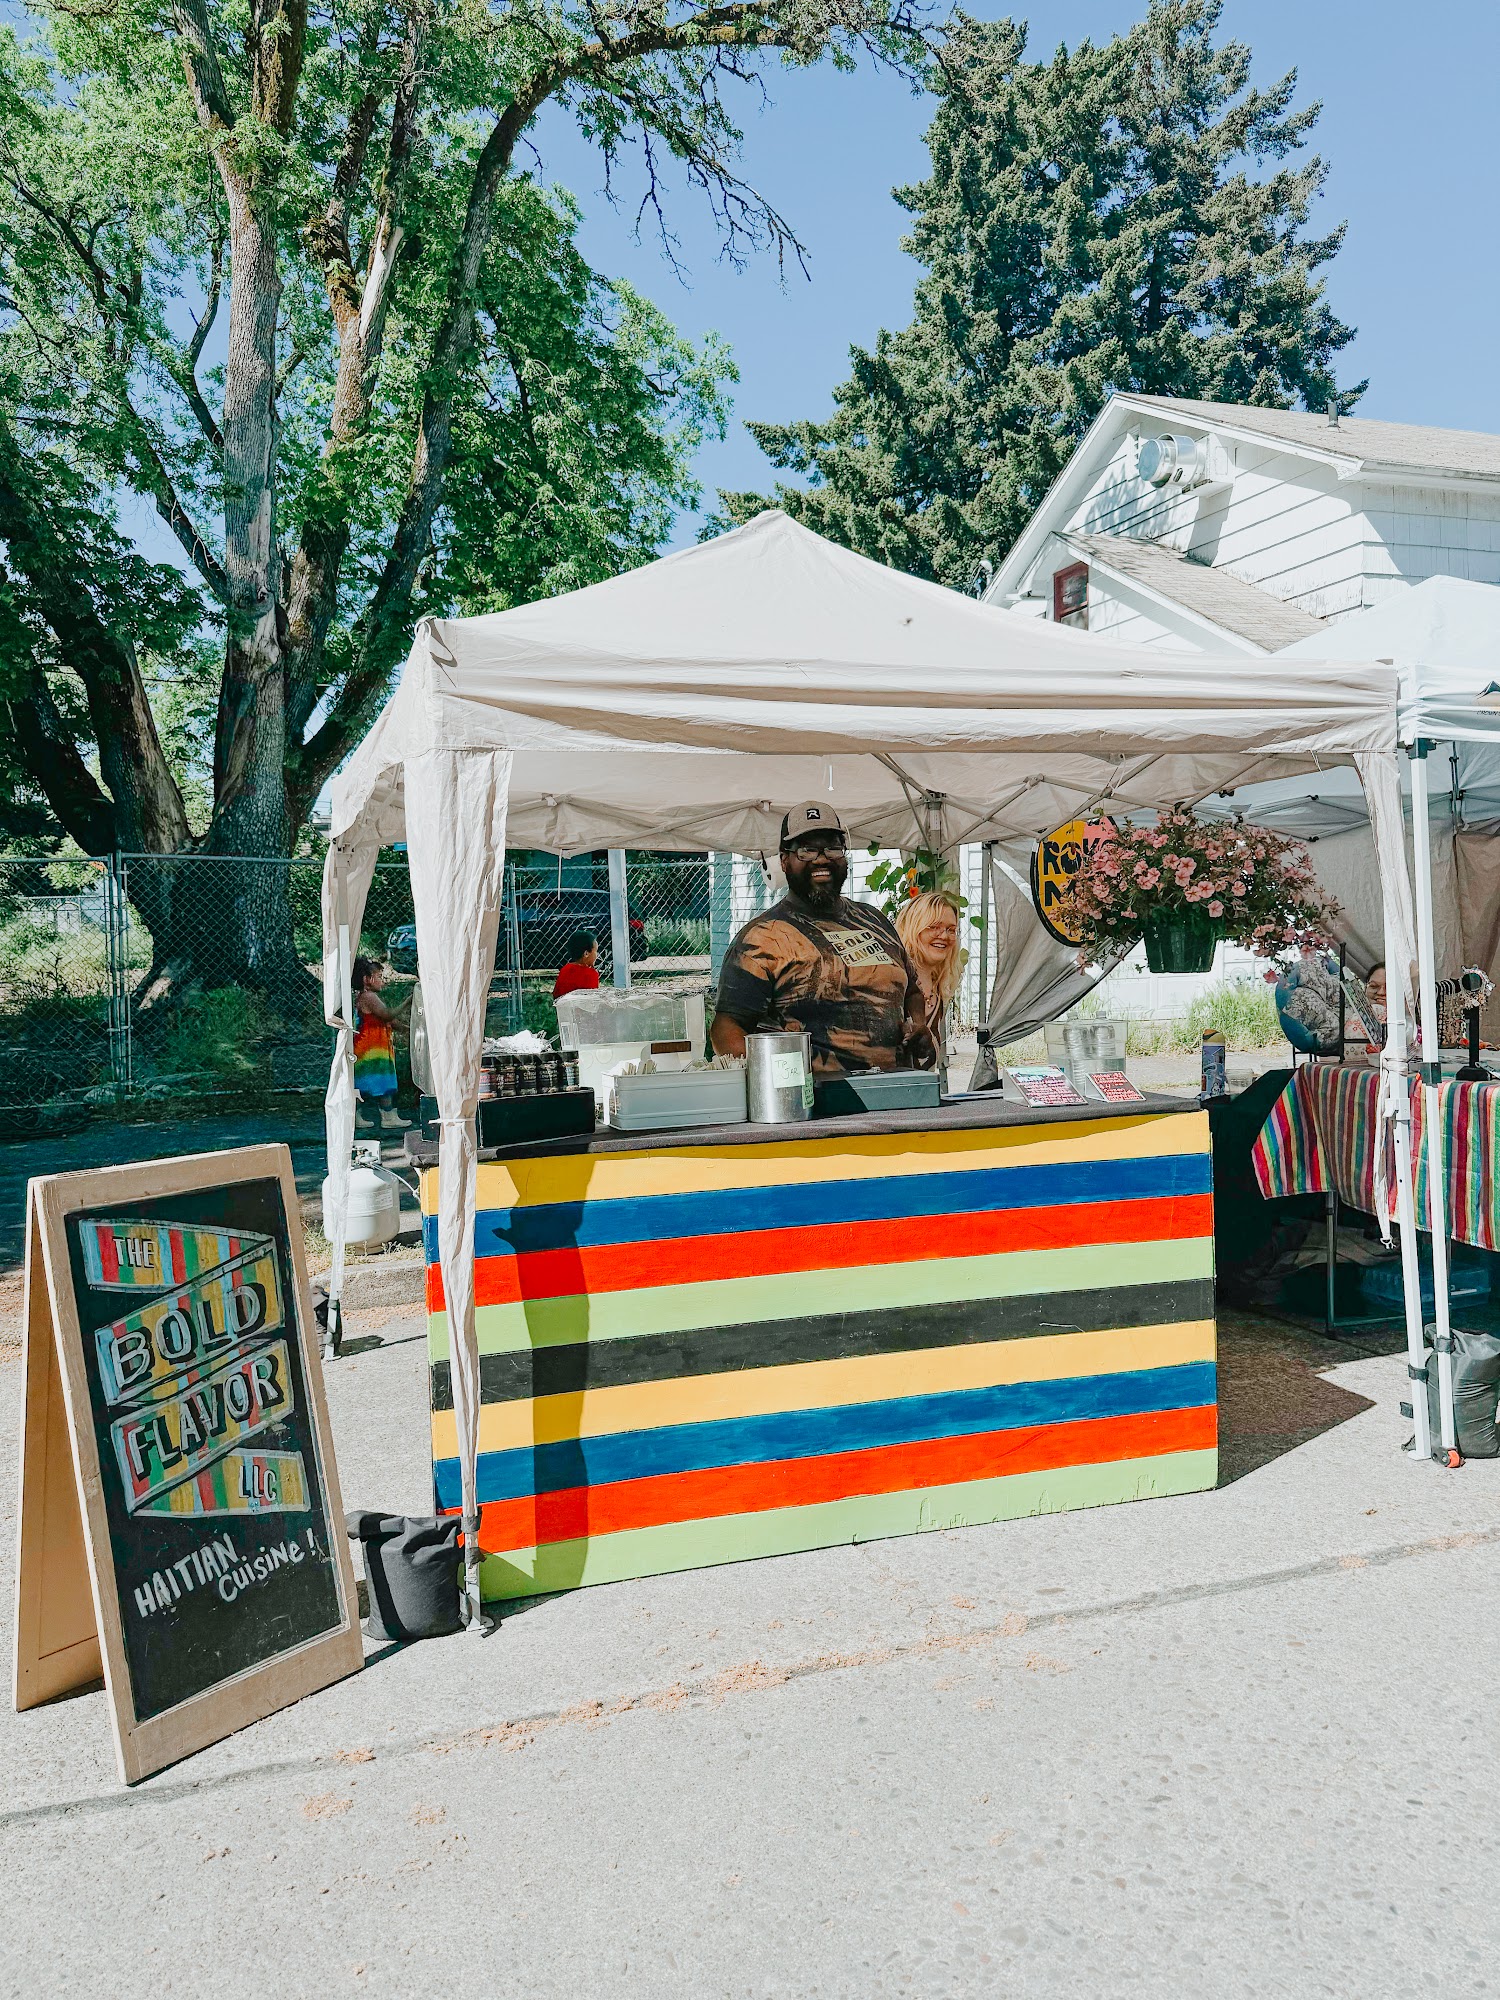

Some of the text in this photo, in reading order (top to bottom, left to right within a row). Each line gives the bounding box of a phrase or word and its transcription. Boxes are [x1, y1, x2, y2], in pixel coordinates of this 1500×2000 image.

[829, 933, 842, 941] THE
[834, 932, 874, 952] BOLD
[843, 943, 883, 965] FLAVOR
[112, 1236, 156, 1269] THE
[110, 1284, 264, 1390] BOLD
[128, 1355, 282, 1480] FLAVOR
[238, 1464, 278, 1501] LLC
[133, 1532, 240, 1619] HAITIAN
